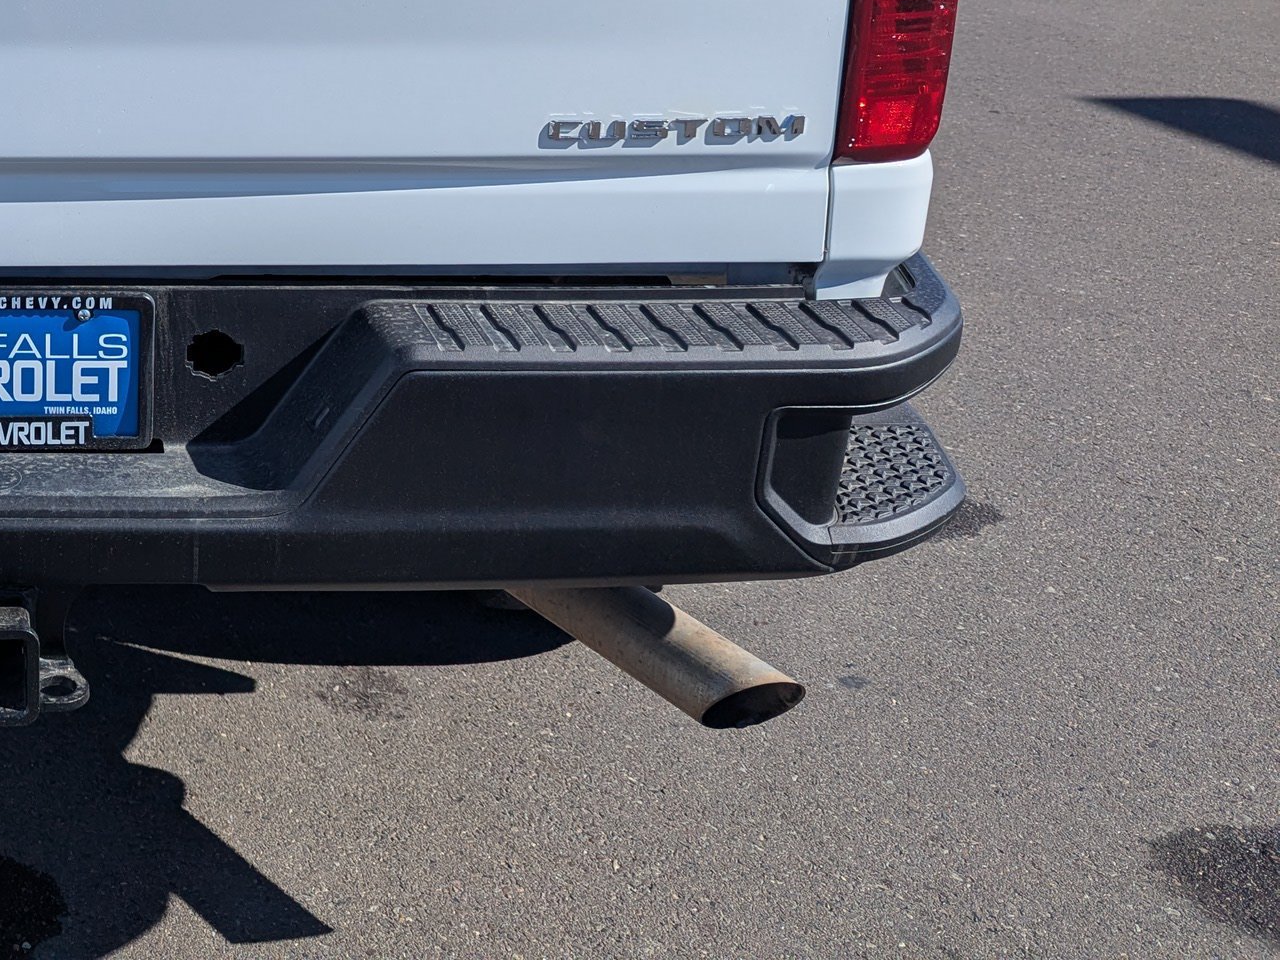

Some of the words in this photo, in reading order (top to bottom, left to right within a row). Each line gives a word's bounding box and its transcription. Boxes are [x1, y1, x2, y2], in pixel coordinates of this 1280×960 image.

[546, 114, 806, 142] CUSTOM
[43, 406, 65, 415] TWIN
[66, 406, 91, 415] FALLS,
[93, 406, 118, 415] IDAHO
